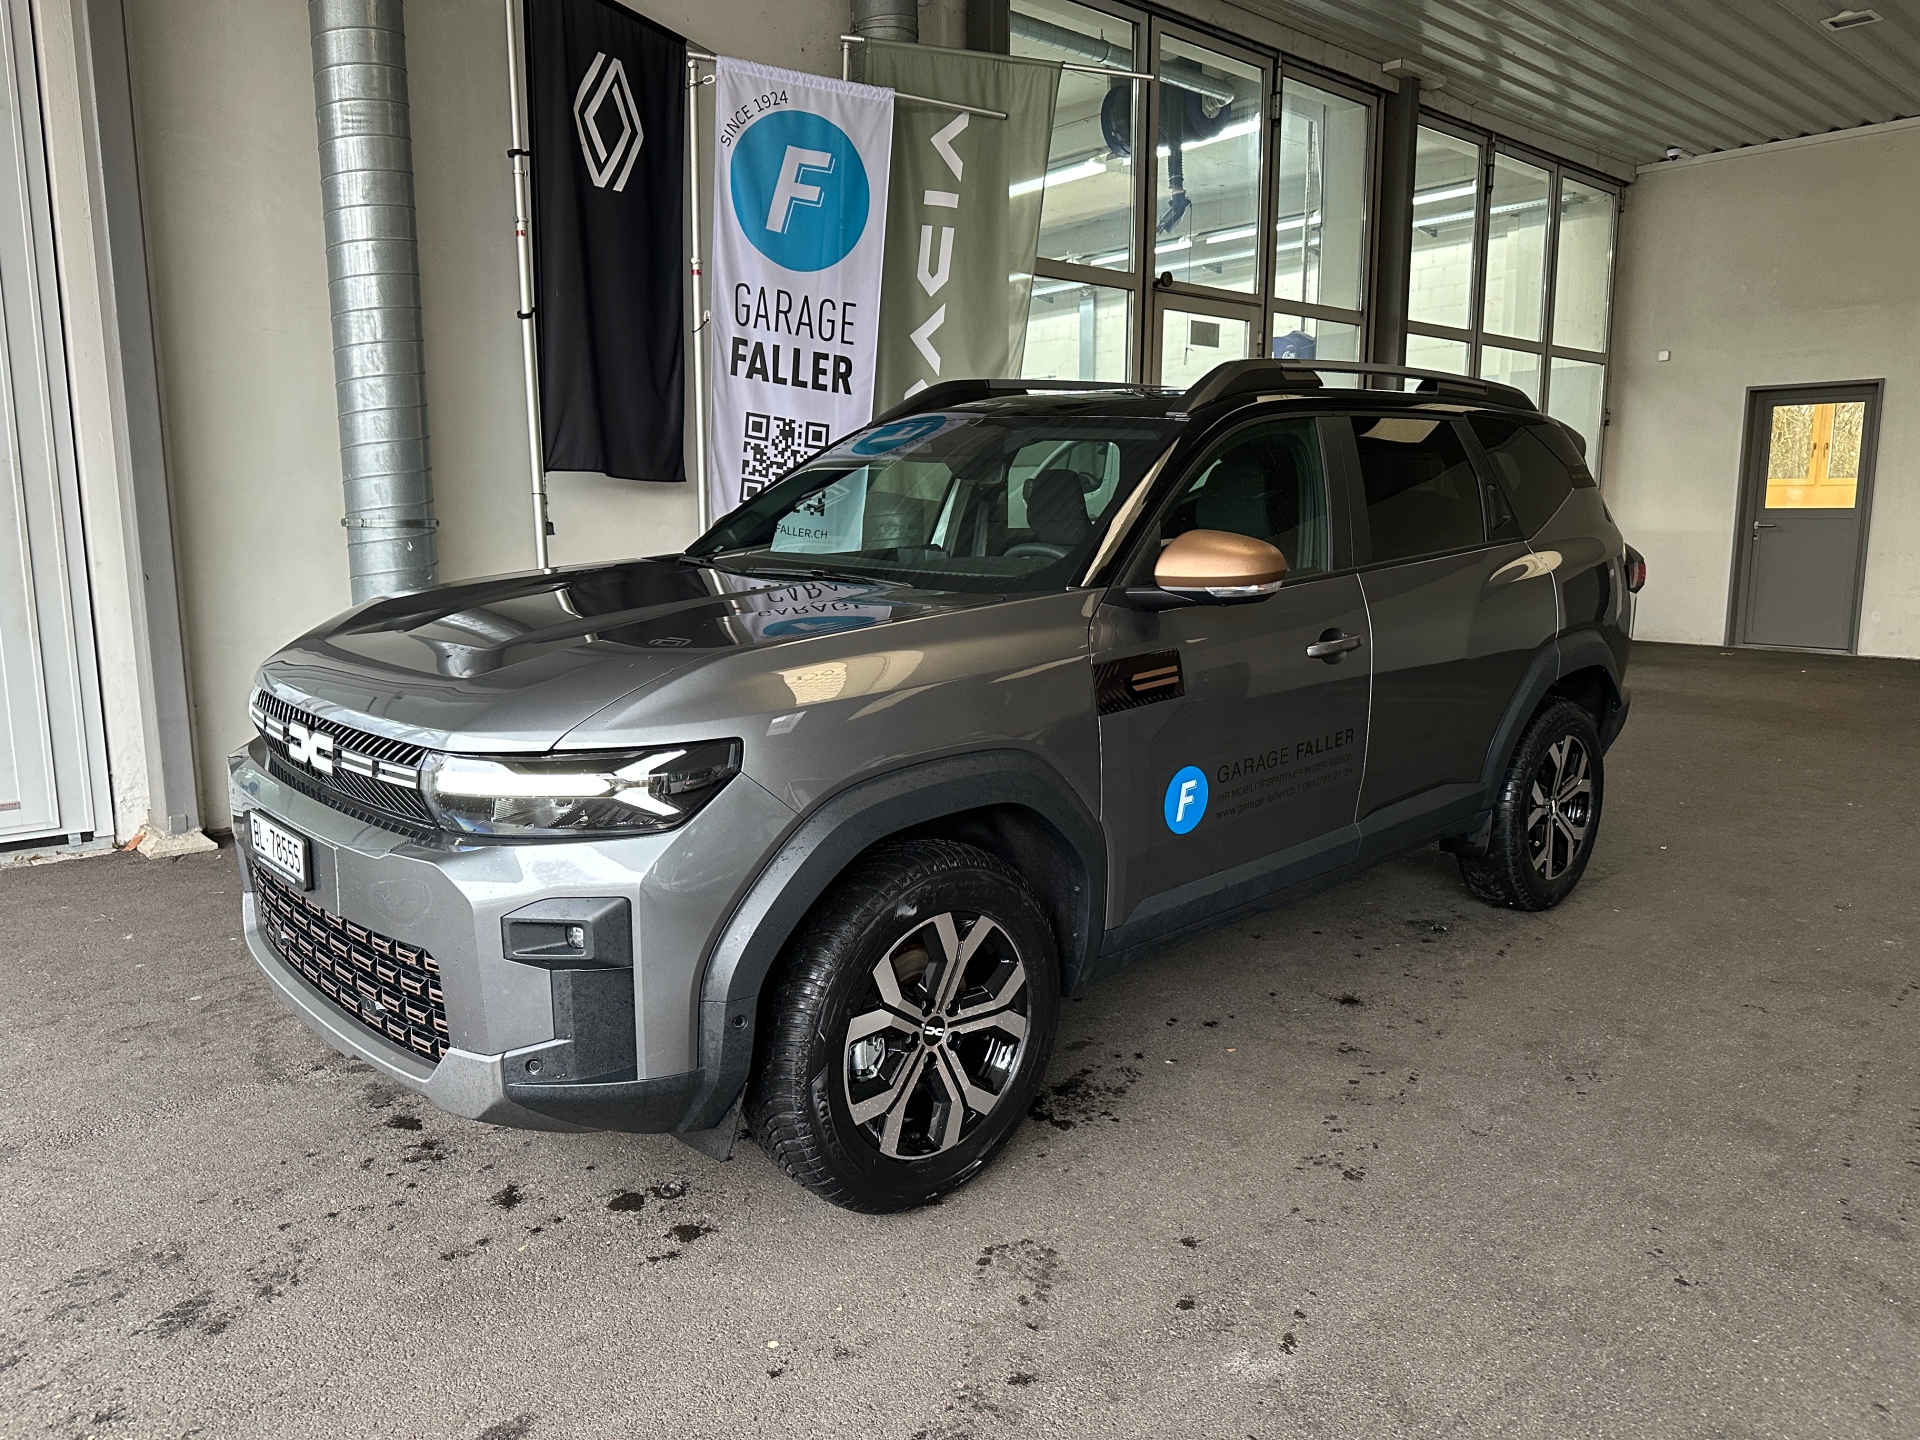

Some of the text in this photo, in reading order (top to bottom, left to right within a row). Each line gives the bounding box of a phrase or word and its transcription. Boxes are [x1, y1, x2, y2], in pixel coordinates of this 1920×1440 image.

[721, 90, 789, 147] SINCE 1924
[766, 145, 836, 234] F
[735, 283, 857, 346] GARAGE
[730, 336, 853, 395] FALLER
[1216, 791, 1230, 803] IHR
[1313, 760, 1327, 772] DER
[1217, 728, 1354, 783] GARAGE FALLER
[1175, 779, 1198, 823] F
